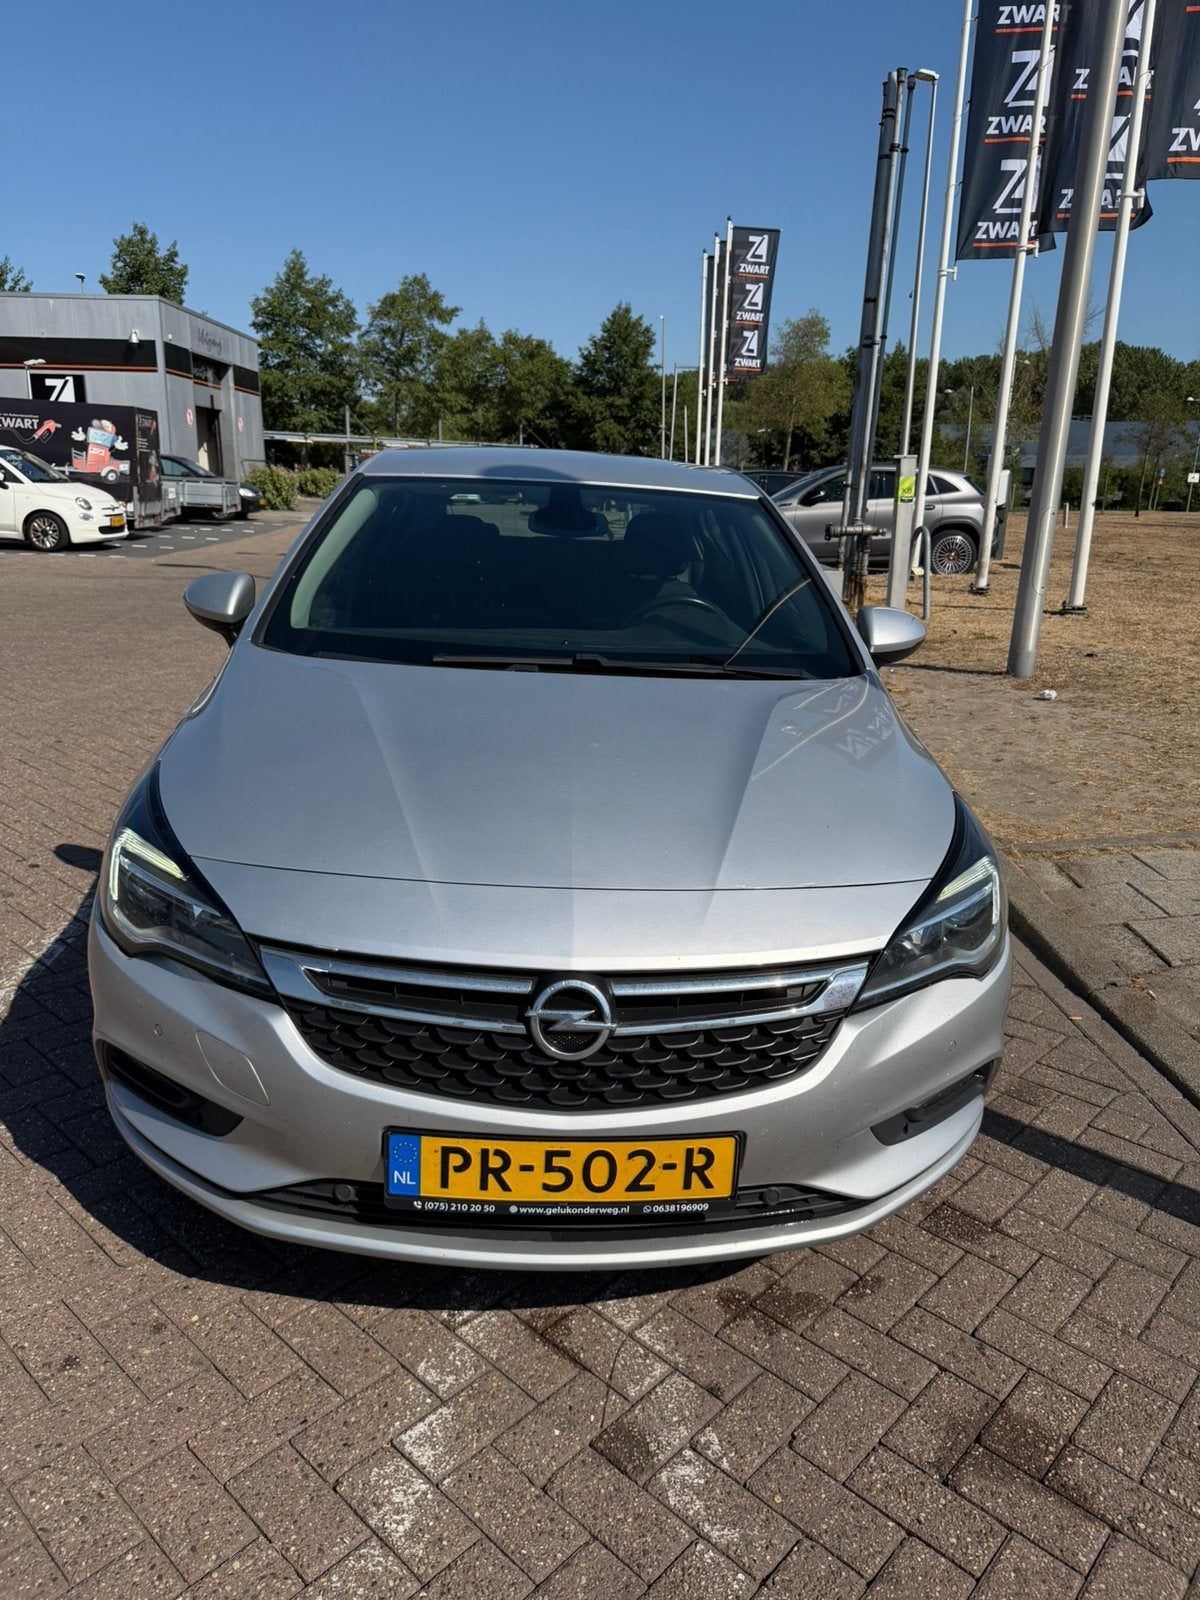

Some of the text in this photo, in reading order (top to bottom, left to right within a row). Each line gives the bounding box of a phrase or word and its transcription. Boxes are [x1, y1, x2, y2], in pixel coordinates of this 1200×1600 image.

[739, 263, 770, 275] ZWART
[736, 311, 764, 322] ZWART
[734, 357, 761, 368] ZWART
[0, 416, 39, 430] WART
[440, 1145, 715, 1193] PR-502-R
[393, 1170, 416, 1185] NL
[424, 1201, 709, 1216] (075) 210 20 50 www.gelukonderweg.nl 0638196909
